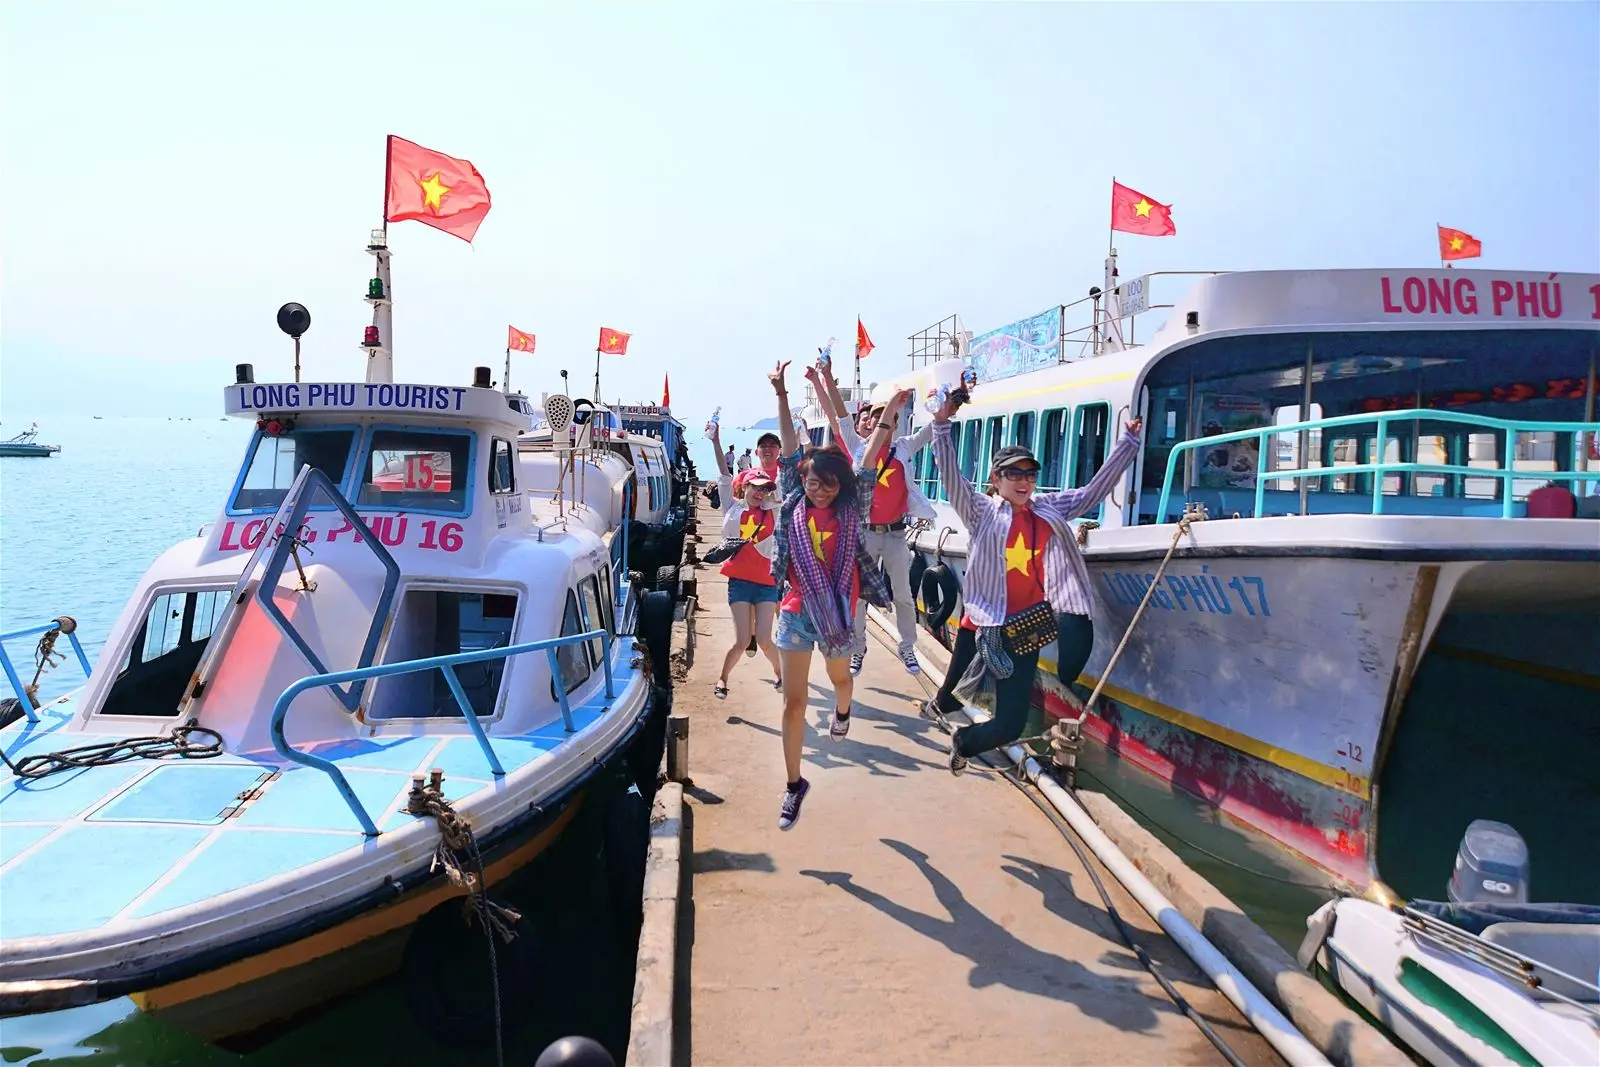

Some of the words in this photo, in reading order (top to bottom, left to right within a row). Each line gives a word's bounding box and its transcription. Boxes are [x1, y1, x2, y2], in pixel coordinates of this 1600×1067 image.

[1381, 276, 1479, 316] LONG
[1491, 273, 1562, 319] PHÚ
[240, 384, 300, 409] LONG
[308, 384, 355, 407] PHU
[364, 384, 467, 411] TOURIST
[405, 454, 433, 490] 15
[418, 519, 464, 552] 16
[1163, 564, 1232, 615] PHÚ
[1228, 575, 1271, 617] 17
[1482, 879, 1513, 894] 60
